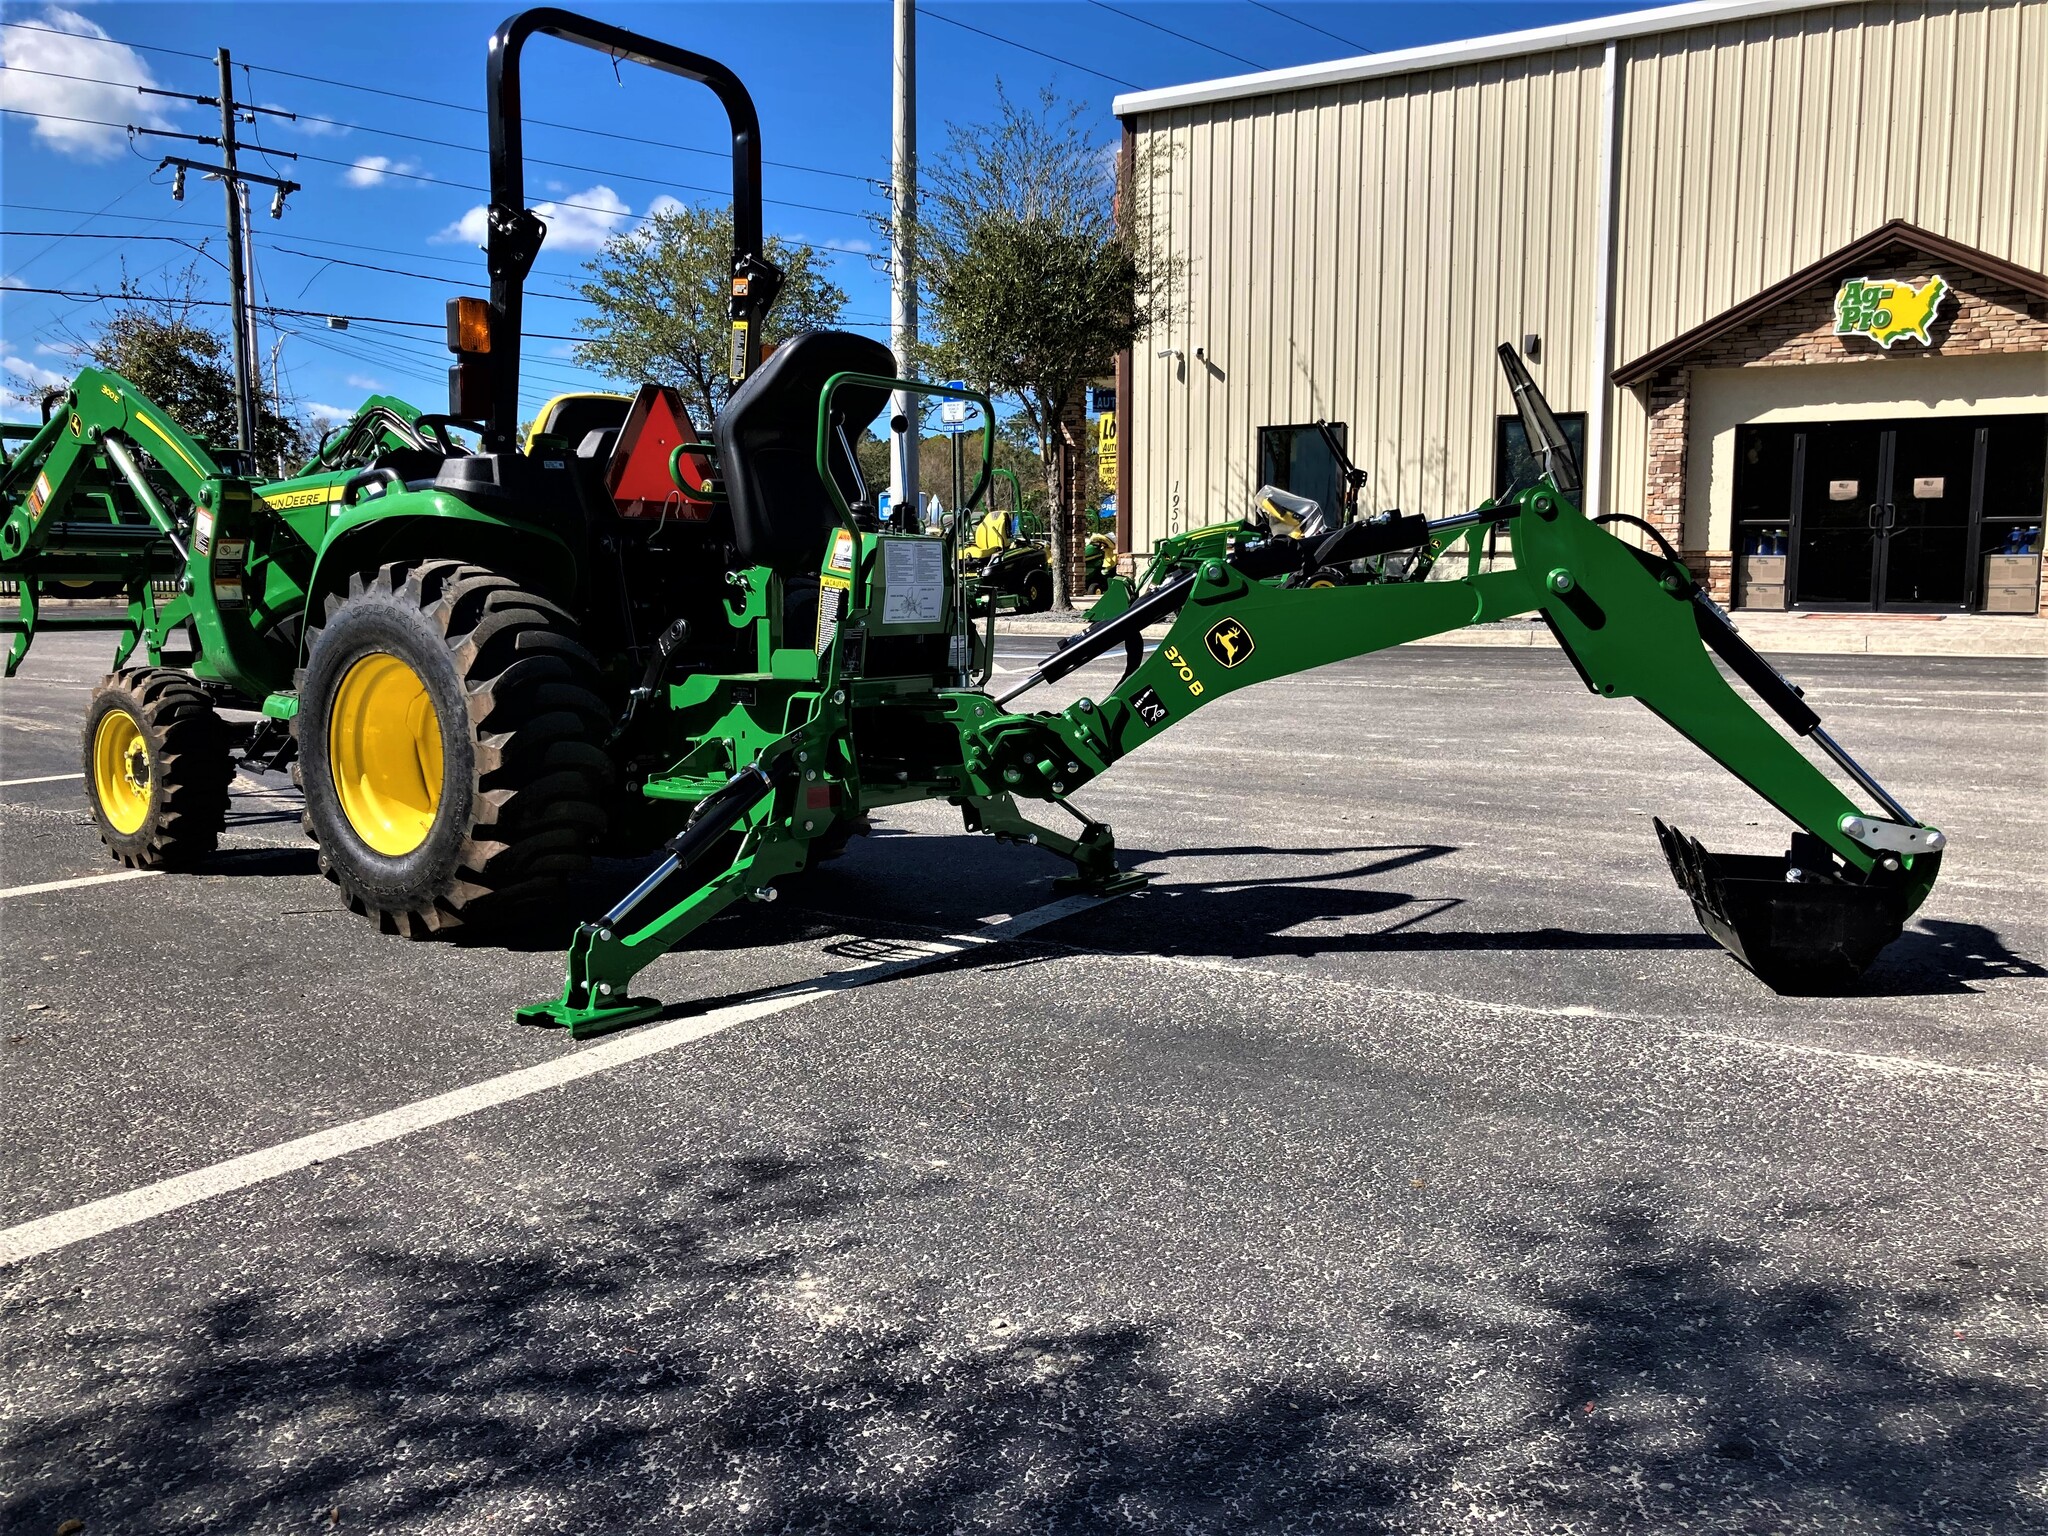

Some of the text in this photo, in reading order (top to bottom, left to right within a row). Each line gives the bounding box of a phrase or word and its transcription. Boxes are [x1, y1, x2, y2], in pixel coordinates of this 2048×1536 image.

[1840, 279, 1893, 311] Ag-
[1836, 306, 1892, 333] Pro
[101, 385, 120, 403] 300 E
[259, 493, 321, 512] JOHN DEERE
[1171, 480, 1180, 535] 1950
[1164, 646, 1204, 696] 370 B
